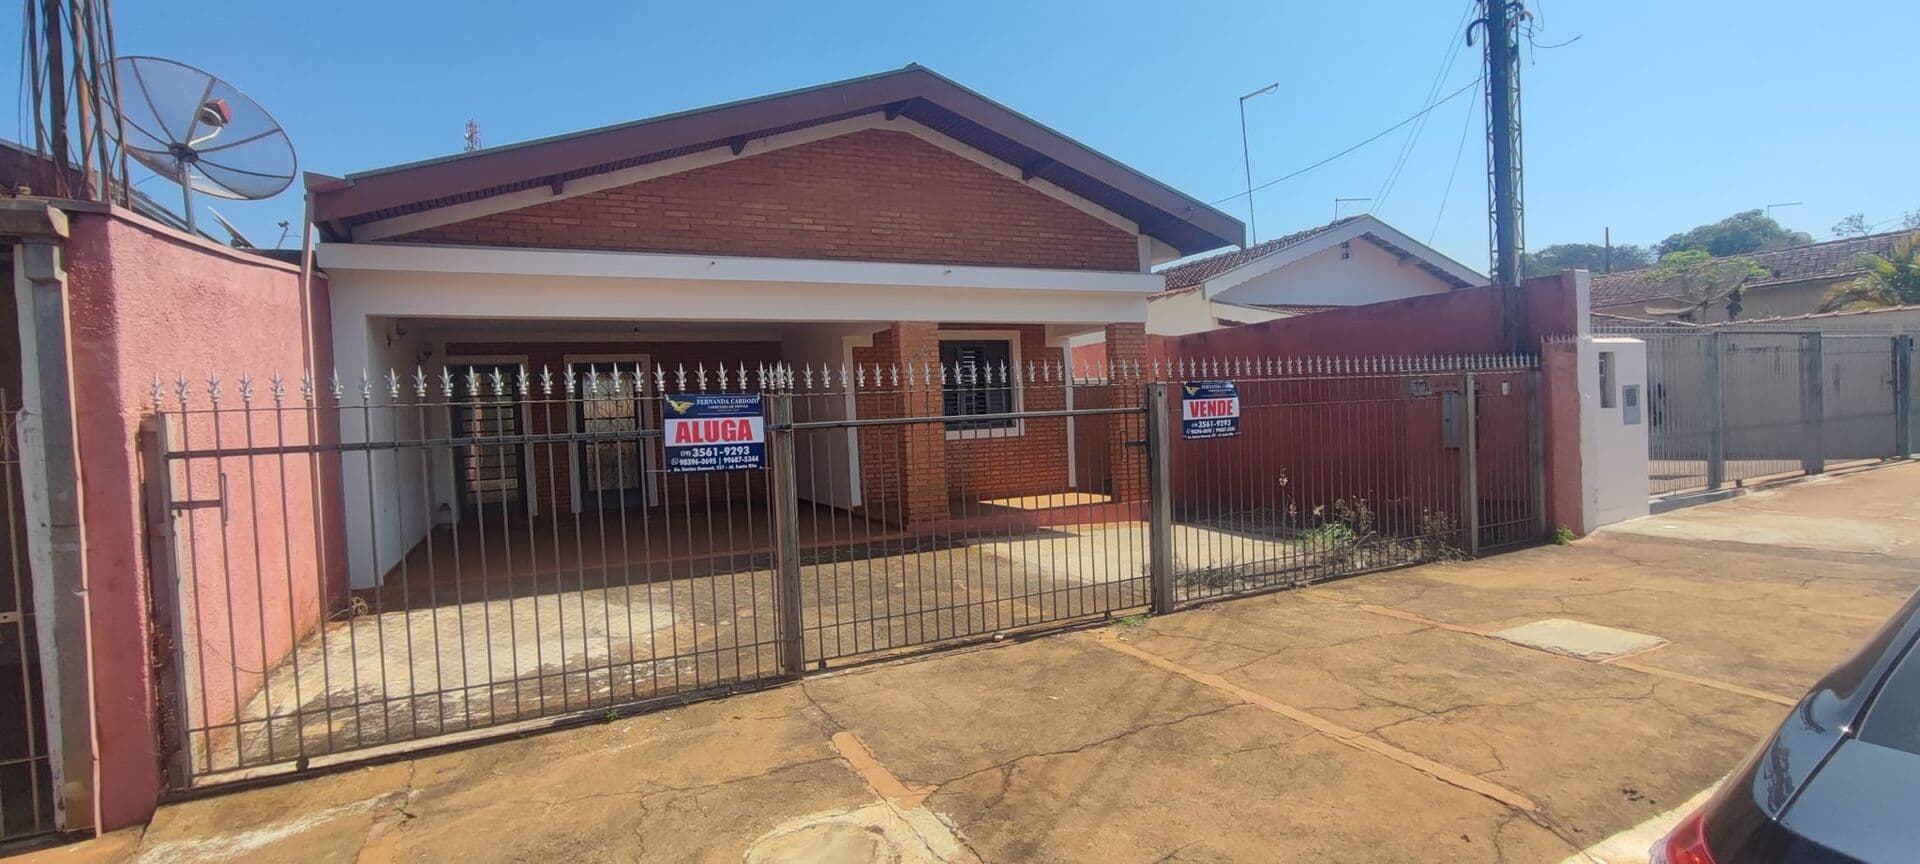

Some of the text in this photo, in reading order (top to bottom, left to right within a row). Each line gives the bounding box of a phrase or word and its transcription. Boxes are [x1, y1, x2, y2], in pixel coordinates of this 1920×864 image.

[1189, 399, 1233, 417] VENDE
[675, 419, 753, 443] ALUGA
[692, 446, 750, 457] 3561-9293
